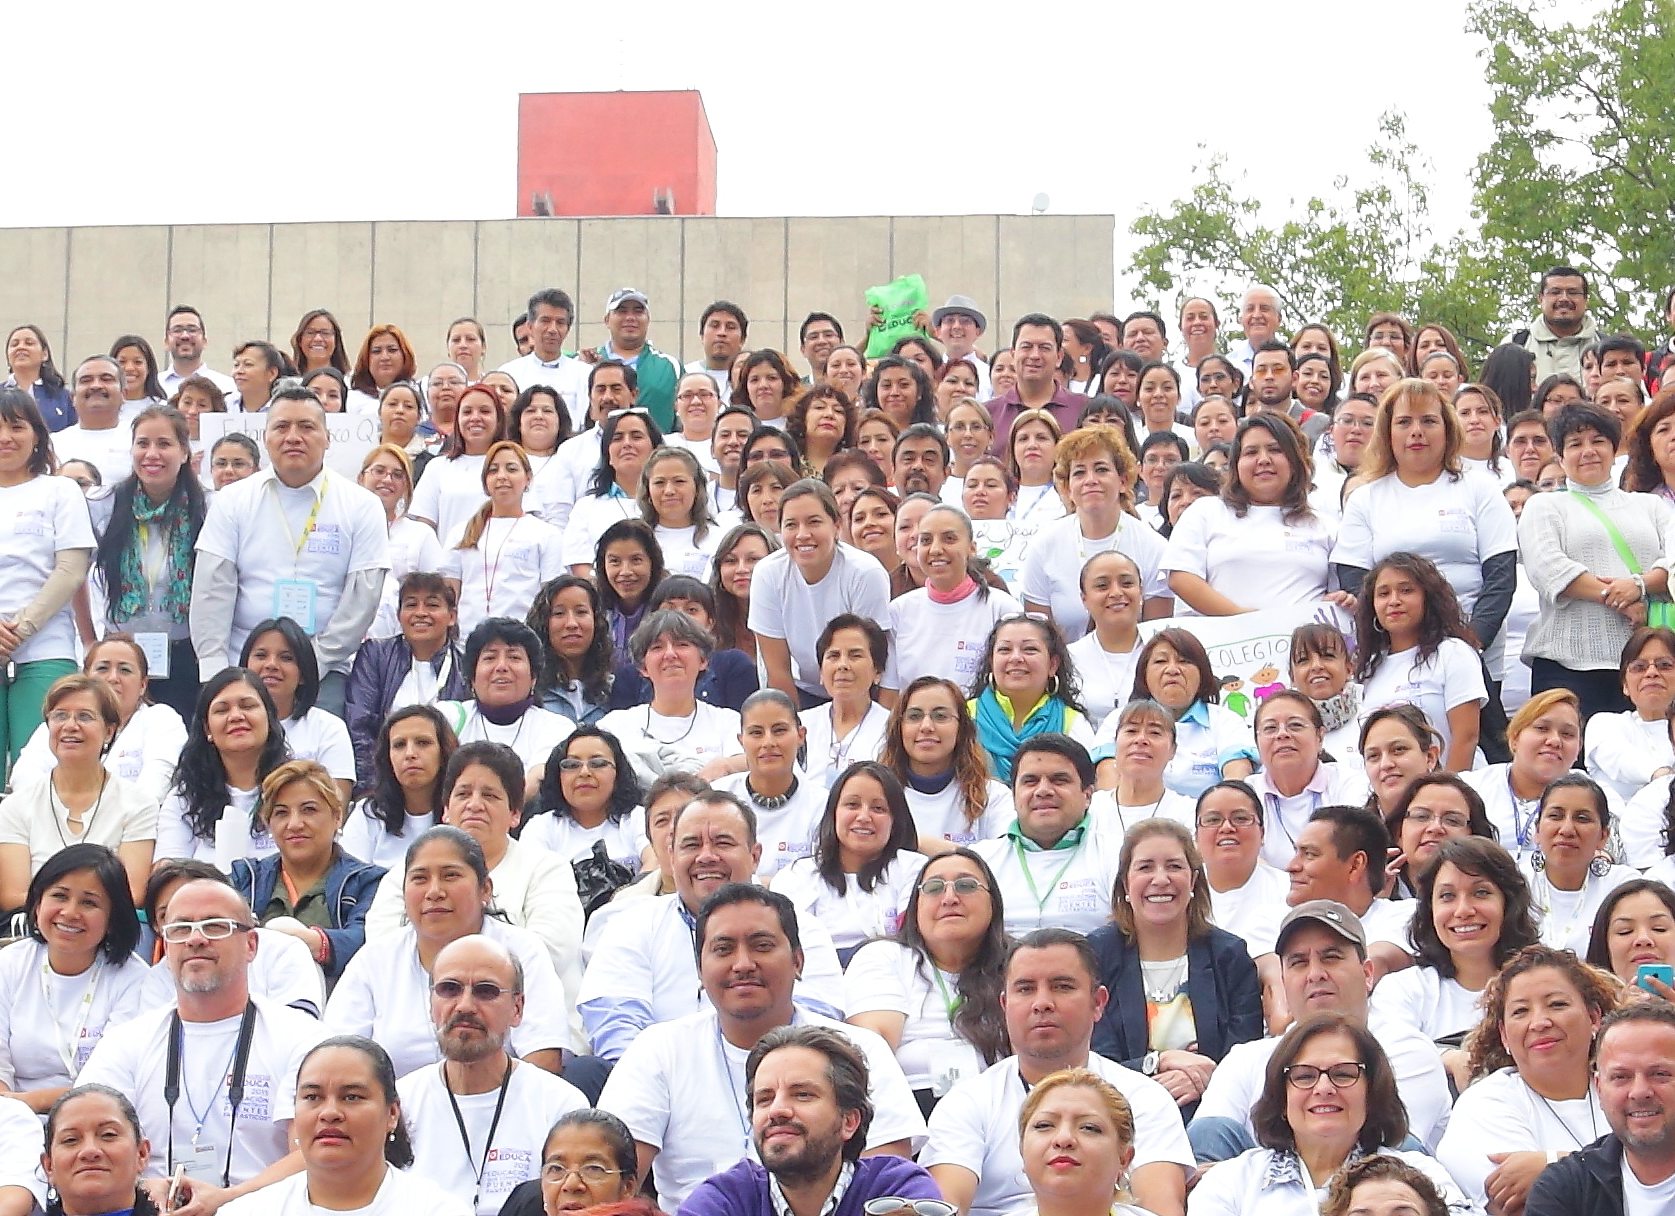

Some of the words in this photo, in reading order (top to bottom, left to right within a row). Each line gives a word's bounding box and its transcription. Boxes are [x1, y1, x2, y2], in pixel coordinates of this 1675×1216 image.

[1209, 639, 1289, 669] COLEGIO
[243, 1080, 269, 1089] DUCA
[500, 1151, 531, 1162] EDUCA
